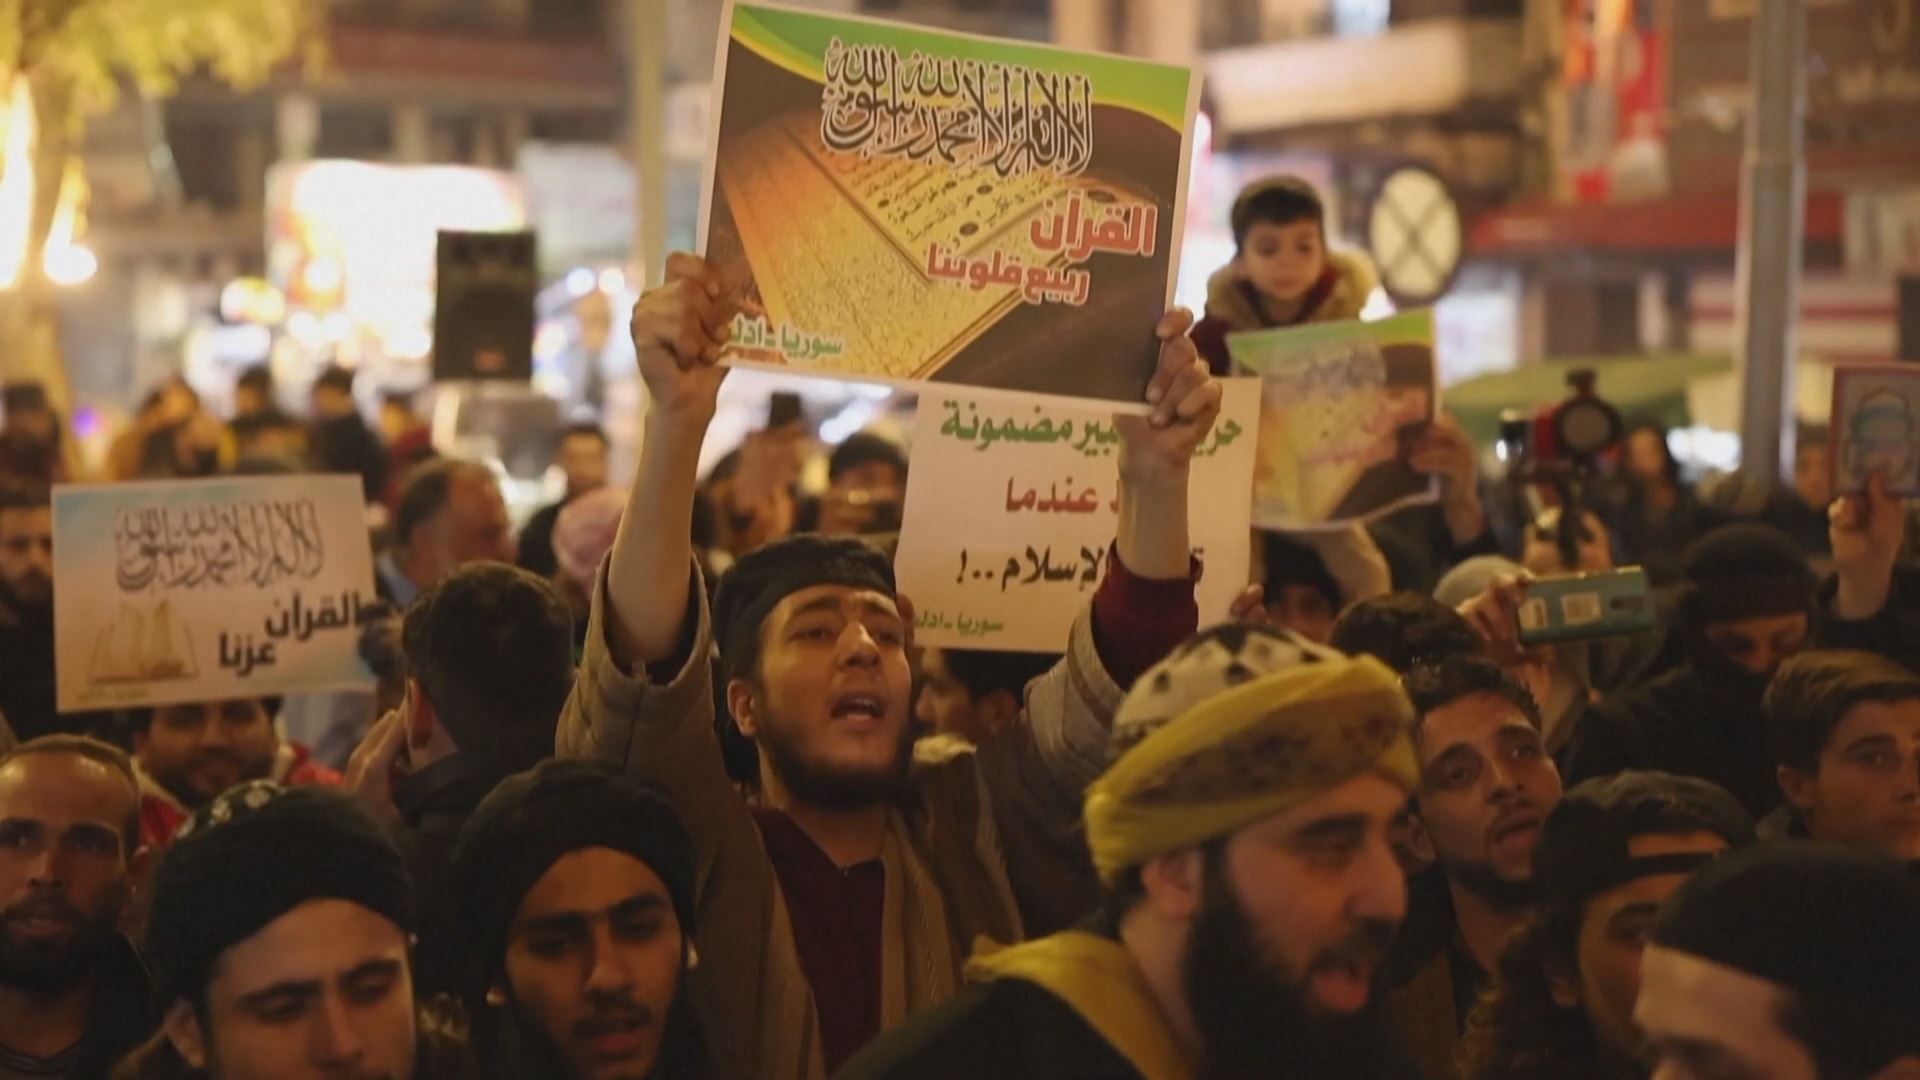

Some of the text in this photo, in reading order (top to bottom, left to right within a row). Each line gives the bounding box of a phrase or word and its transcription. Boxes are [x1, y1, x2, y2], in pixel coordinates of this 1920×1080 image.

[927, 242, 1090, 304] ربيع قلوبنا
[729, 315, 763, 345] ادل
[782, 323, 842, 358] سوريا
[940, 400, 1073, 452] مضمونة
[1005, 476, 1099, 513] عندما
[1001, 545, 1104, 592] لإسلام
